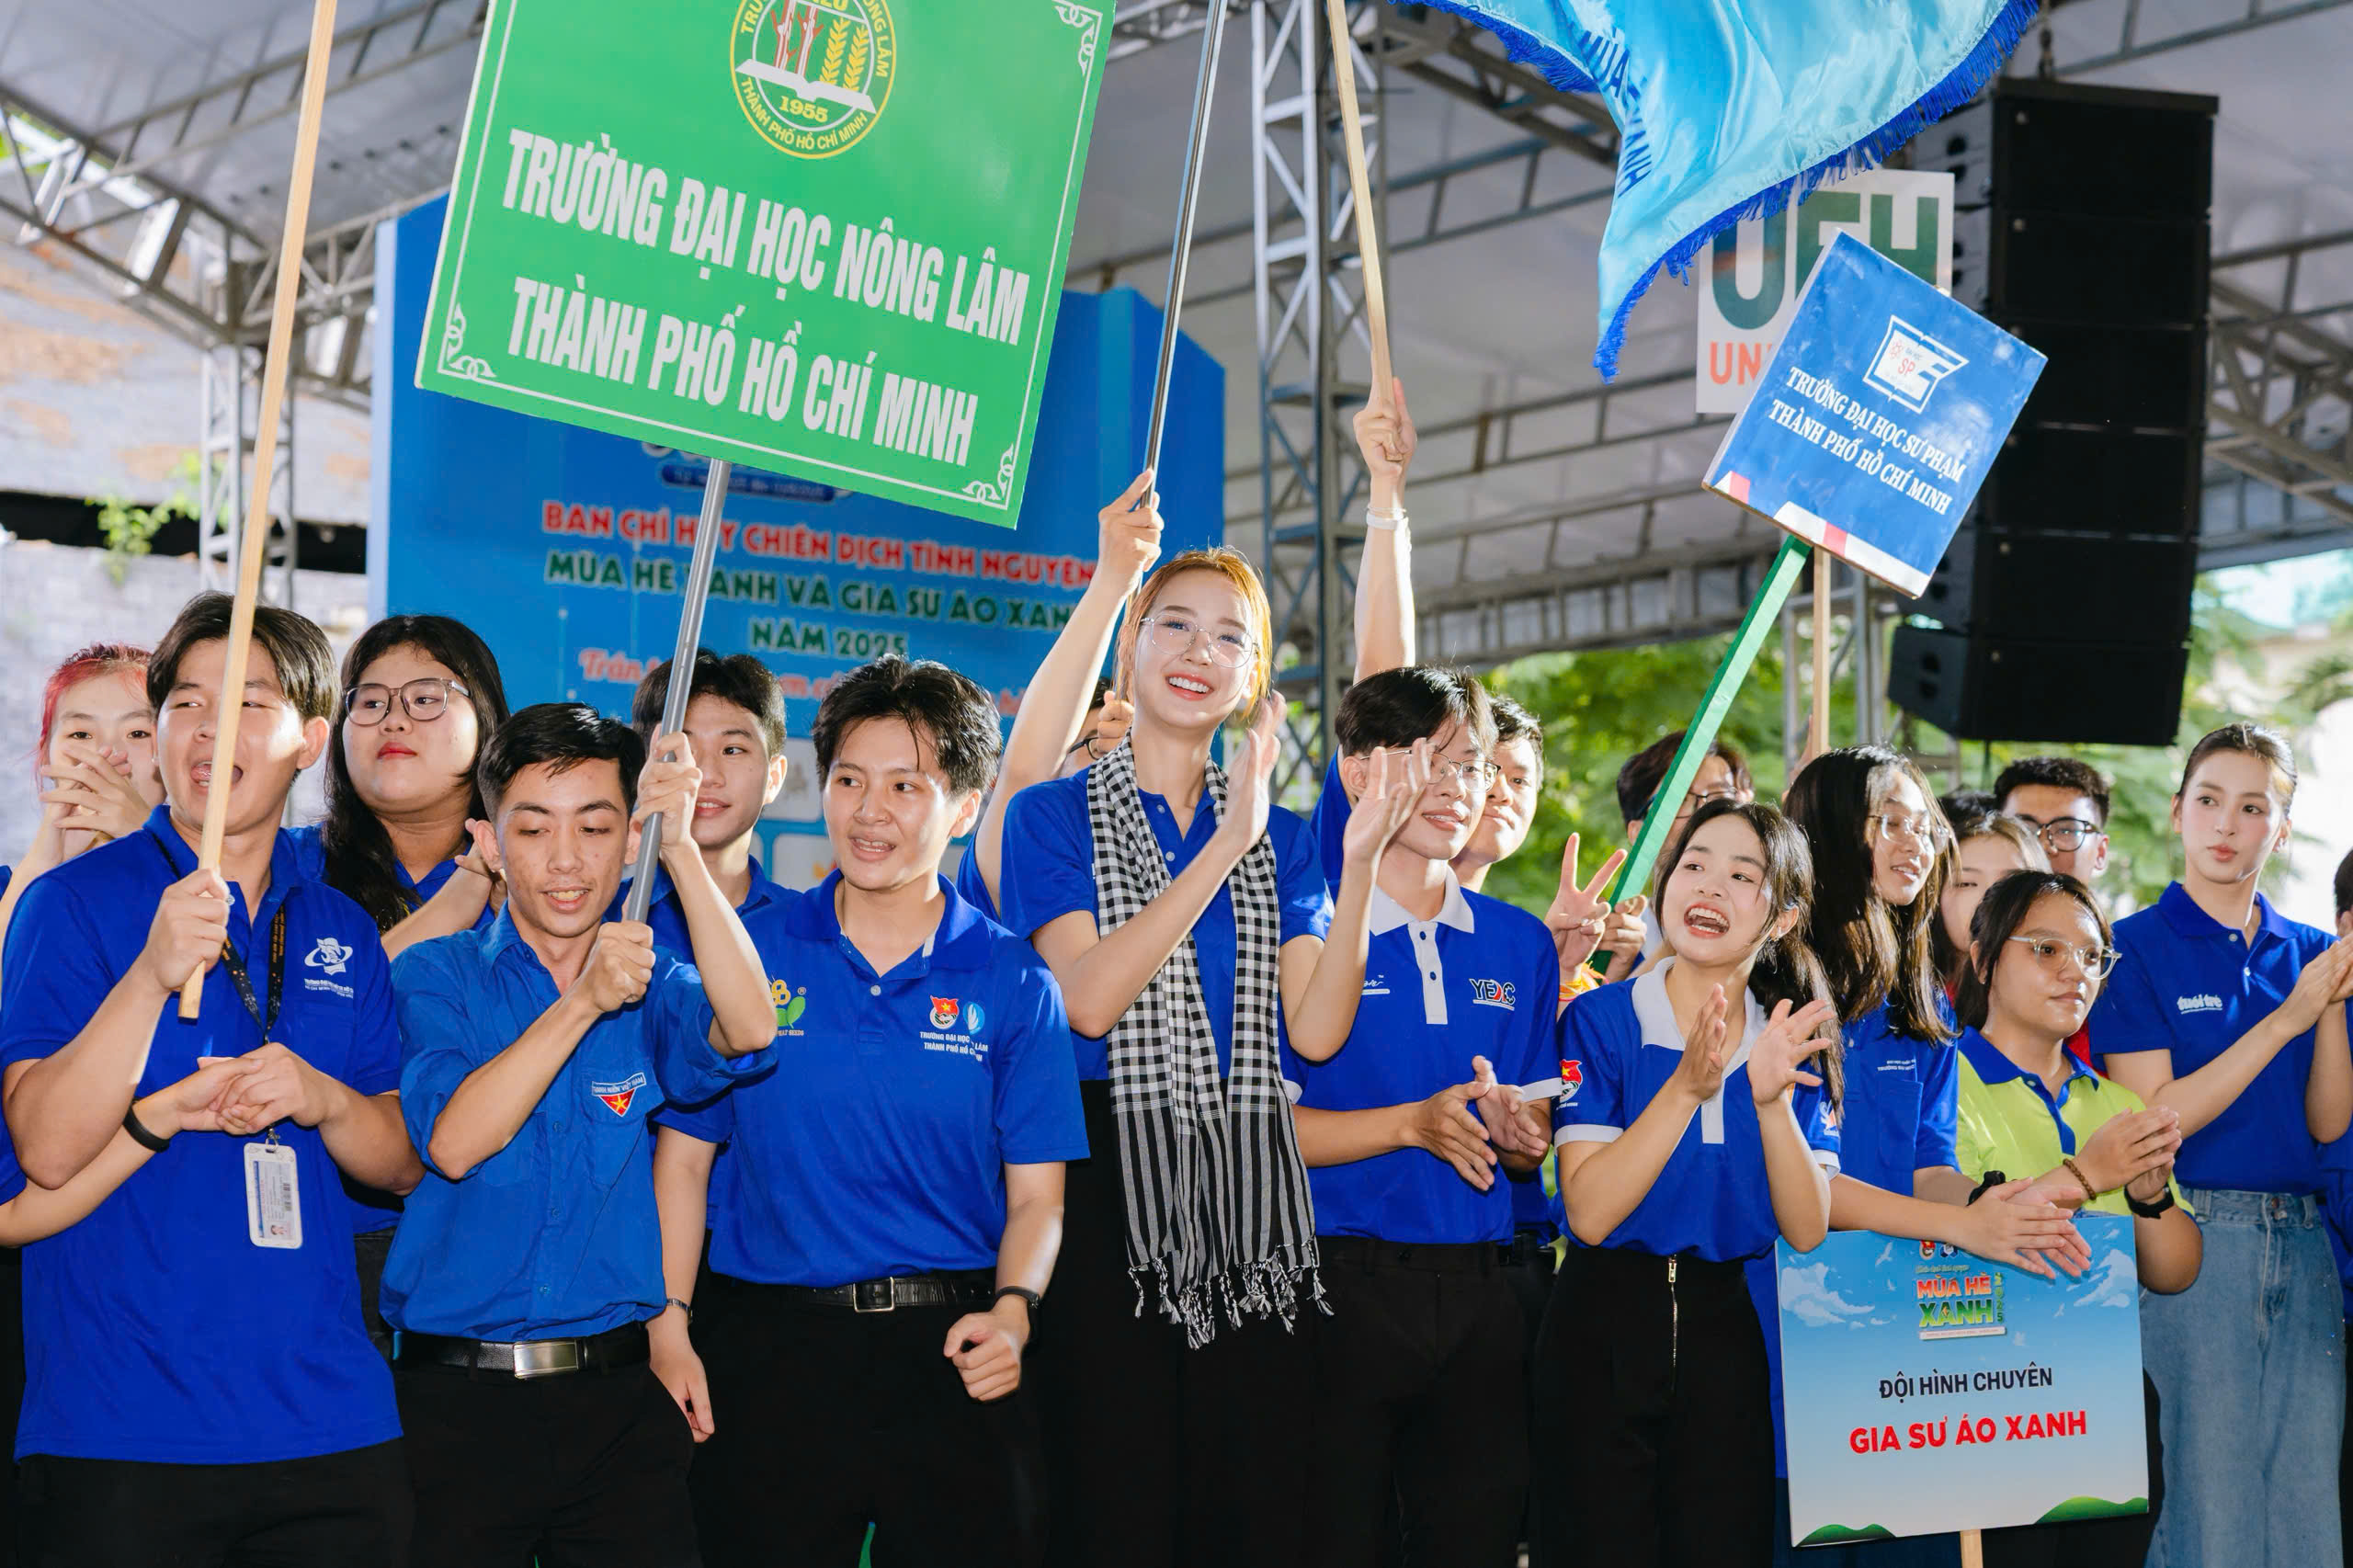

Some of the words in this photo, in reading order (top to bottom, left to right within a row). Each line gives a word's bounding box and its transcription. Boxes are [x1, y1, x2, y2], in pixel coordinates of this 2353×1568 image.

[875, 35, 892, 77] LÂM
[741, 77, 771, 127] THÀNH
[768, 120, 796, 145] PHỐ
[795, 131, 815, 151] HỒ
[816, 130, 838, 150] CHÍ
[838, 112, 869, 142] MINH
[779, 95, 829, 123] 1955
[502, 128, 668, 248] TRƯỜNG
[668, 176, 746, 280] ĐẠI
[746, 198, 831, 301] HỌC
[833, 216, 944, 323] NÔNG
[945, 245, 1030, 347] LÂM
[507, 273, 647, 384] THÀNH
[647, 304, 745, 406] PHỐ
[738, 320, 802, 421] HỒ
[802, 350, 878, 440] CHÍ
[873, 371, 979, 467] MINH
[1898, 358, 1915, 376] SP
[1786, 365, 1849, 415] TRƯỜNG
[1844, 400, 1874, 430] ĐẠI
[1870, 418, 1908, 449] HỌC
[1902, 434, 1928, 458] SƯ
[1919, 446, 1967, 483] PHẠM
[1768, 399, 1827, 445] THÀNH
[1822, 430, 1863, 462] PHỐ
[1855, 449, 1884, 476] HỒ
[1880, 463, 1914, 492] CHÍ
[1905, 477, 1953, 516] MINH
[543, 500, 612, 537] BAN
[676, 515, 739, 551] HY
[836, 533, 904, 568] DỊCH
[910, 539, 976, 577] TÌNH
[546, 550, 624, 585] MÙA
[684, 564, 777, 601] ANH
[840, 583, 898, 615] GIA
[751, 617, 827, 653] NĂM
[836, 630, 908, 658] 2025
[919, 1030, 944, 1040] TRƯỜNG
[945, 1033, 956, 1042] ĐẠI
[957, 1034, 971, 1044] HỌC
[924, 1040, 945, 1051] THÀNH
[1916, 1274, 1961, 1299] MÙA
[1964, 1272, 1992, 1296] HÈ
[1918, 1299, 1994, 1327] XANH
[1879, 1370, 1915, 1403] ĐỘI
[1919, 1369, 1968, 1396] HÌNH
[1973, 1360, 2053, 1392] CHUYÊN
[1848, 1425, 1902, 1455] GIA
[1908, 1415, 1949, 1449] SƯ
[1955, 1414, 1997, 1446] ÁO
[2004, 1410, 2087, 1442] XANH
